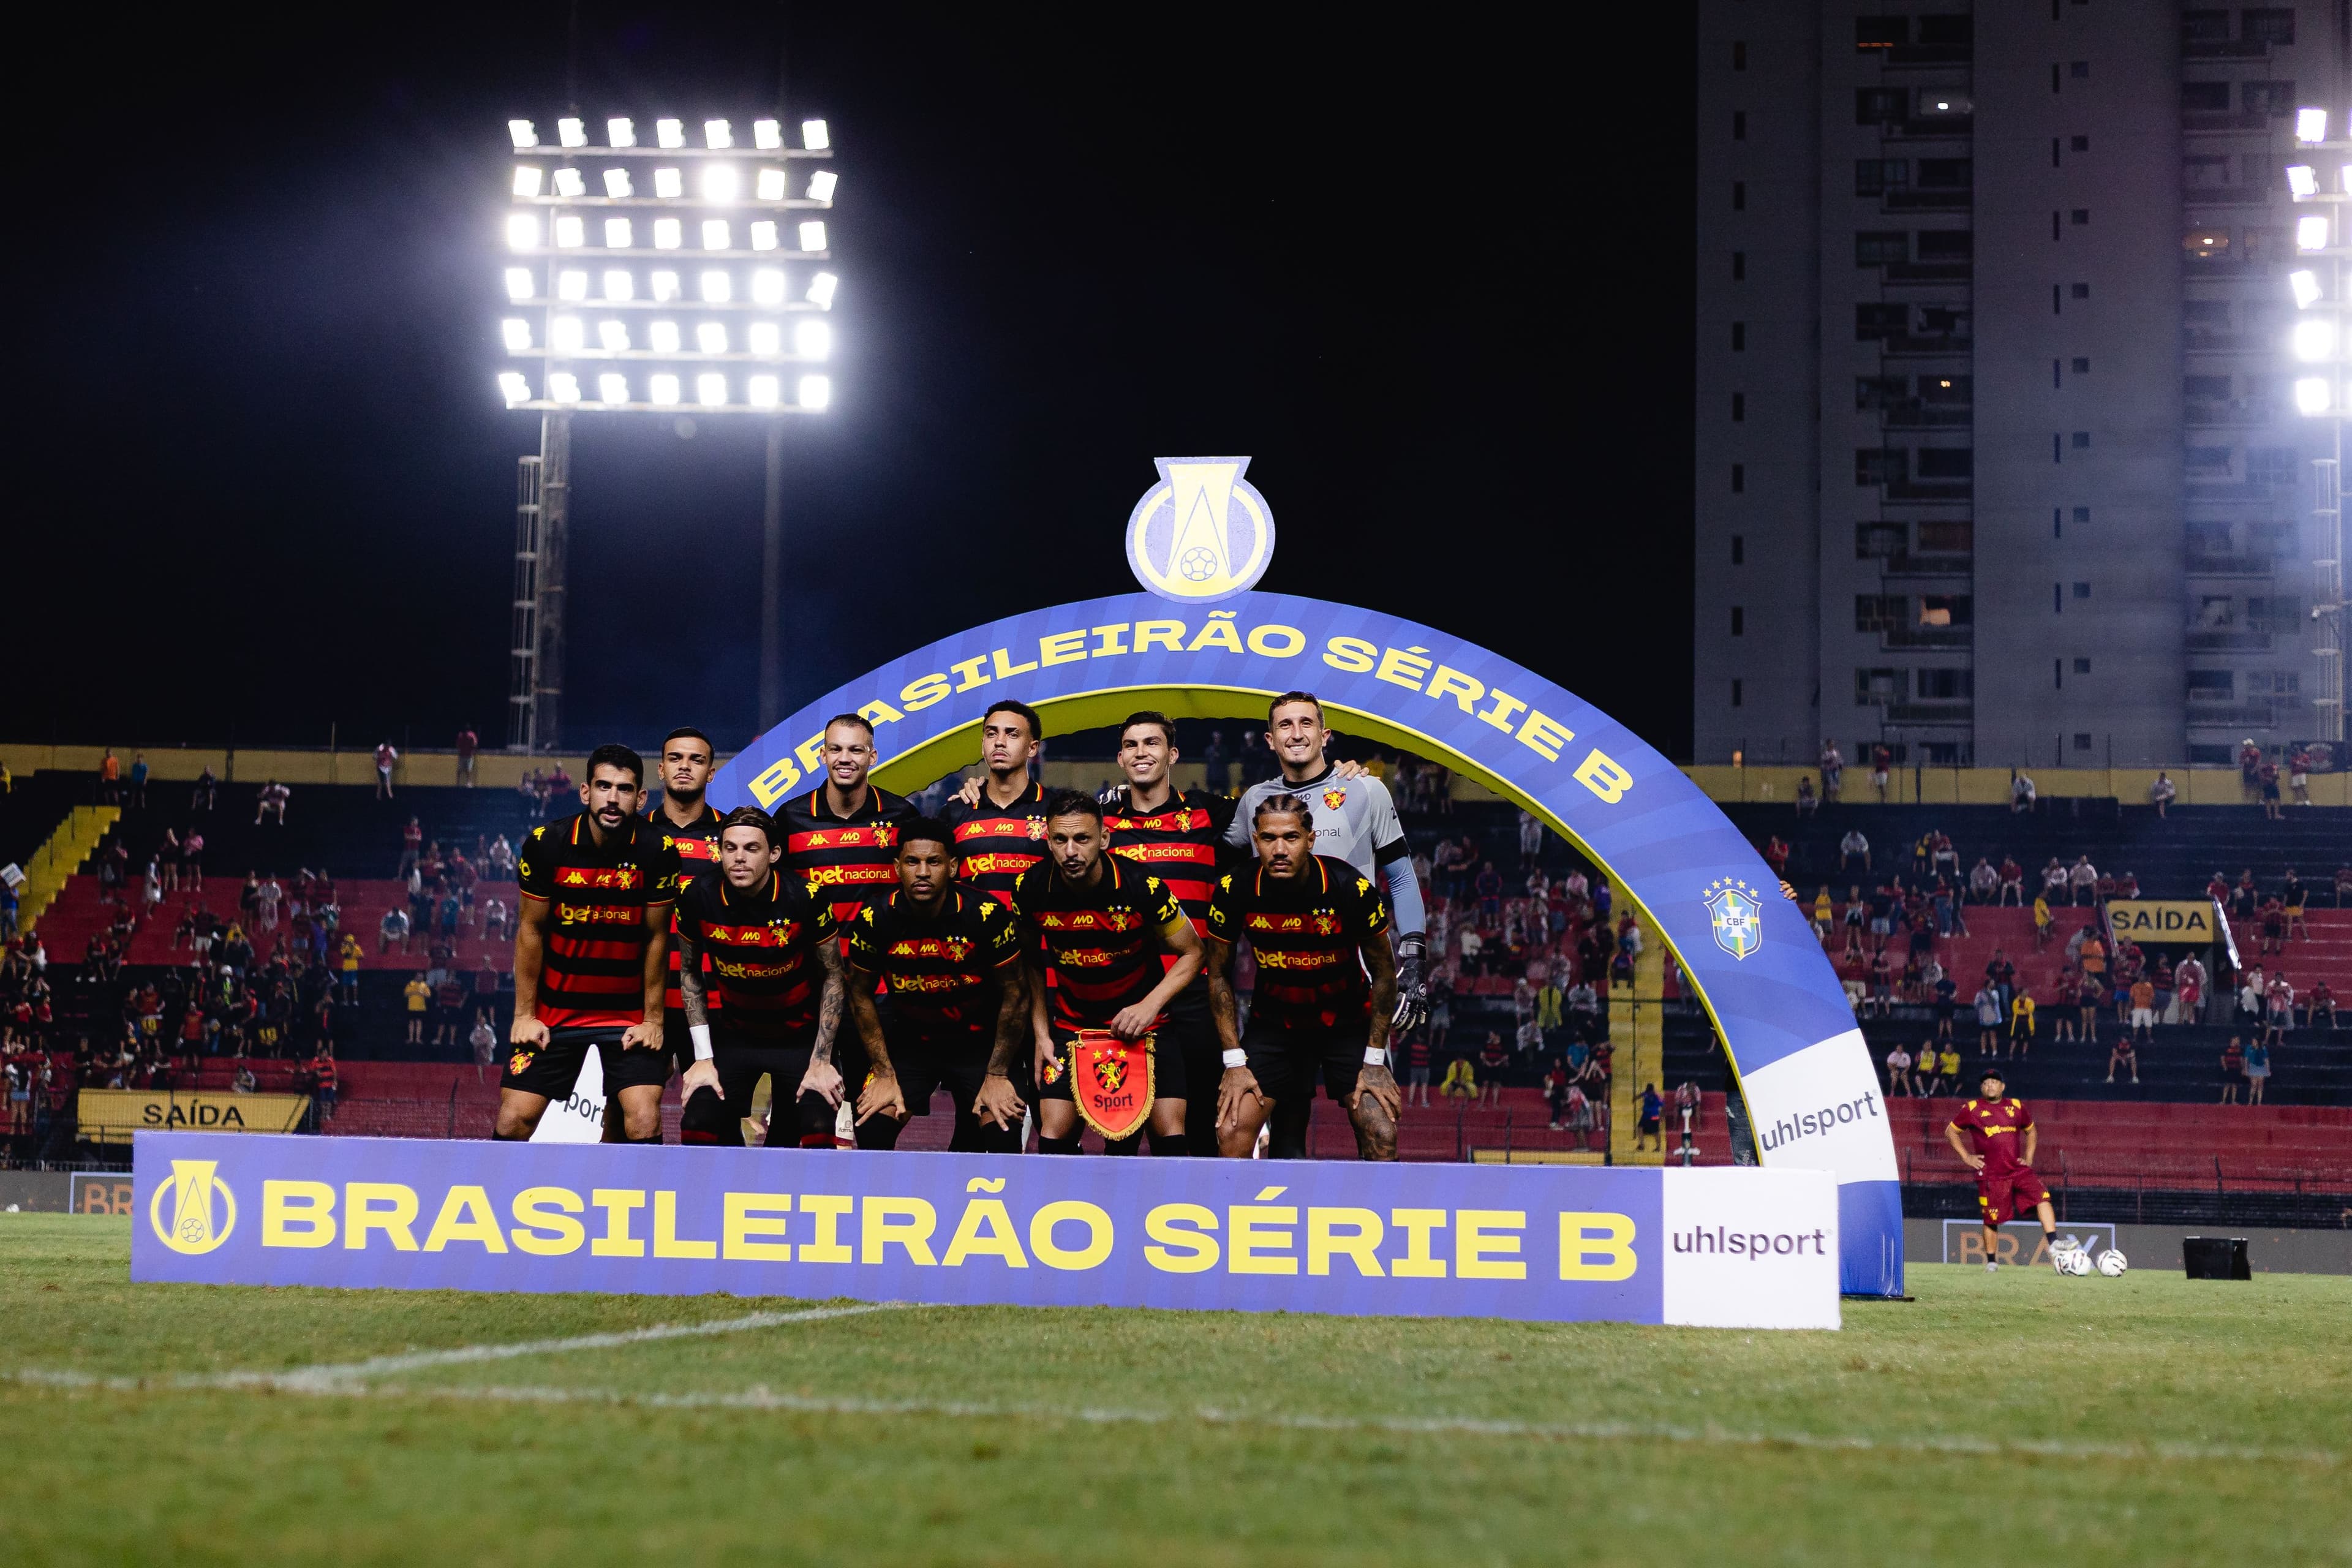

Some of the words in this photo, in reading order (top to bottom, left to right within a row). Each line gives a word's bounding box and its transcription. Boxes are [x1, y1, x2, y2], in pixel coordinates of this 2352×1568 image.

[1322, 637, 1574, 761] SÉRIE
[1573, 748, 1633, 804] B
[2111, 907, 2207, 930] SAÍDA
[143, 1099, 244, 1126] SAÍDA
[1094, 1093, 1133, 1112] Sport
[1761, 1091, 1878, 1152] uhlsport
[263, 1177, 1113, 1270] BRASILEIRÃO
[1144, 1186, 1526, 1279] SÉRIE
[1559, 1212, 1637, 1281] B
[1673, 1226, 1825, 1261] uhlsport
